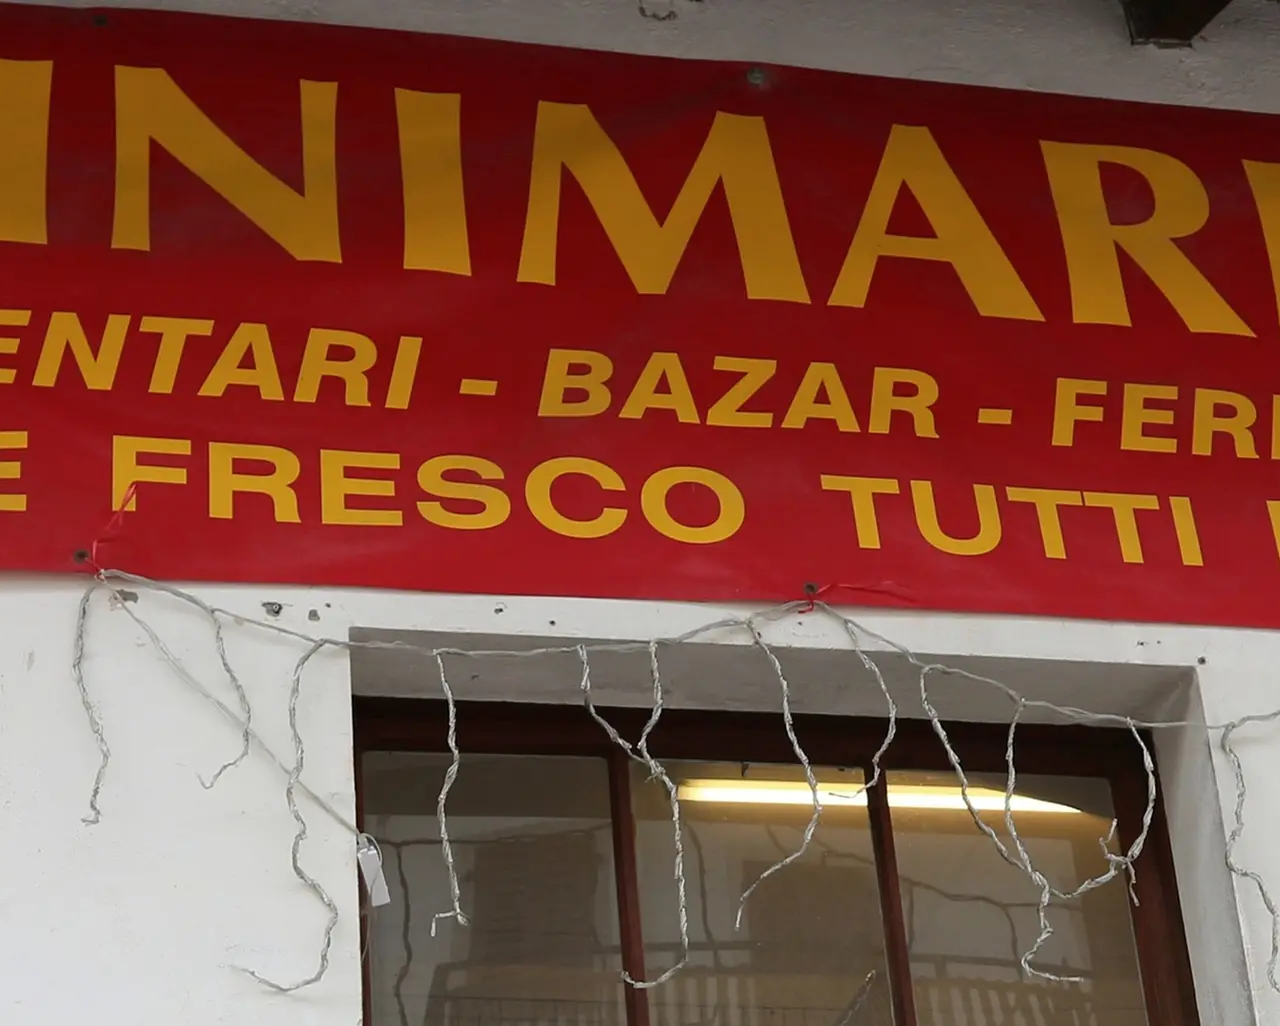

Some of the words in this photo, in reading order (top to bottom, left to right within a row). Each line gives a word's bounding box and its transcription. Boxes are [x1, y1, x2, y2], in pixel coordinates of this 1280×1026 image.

[460, 378, 498, 396] -
[539, 349, 939, 439] BAZAR
[978, 408, 1013, 425] -
[111, 435, 746, 544] FRESCO
[820, 474, 1205, 568] TUTTI
